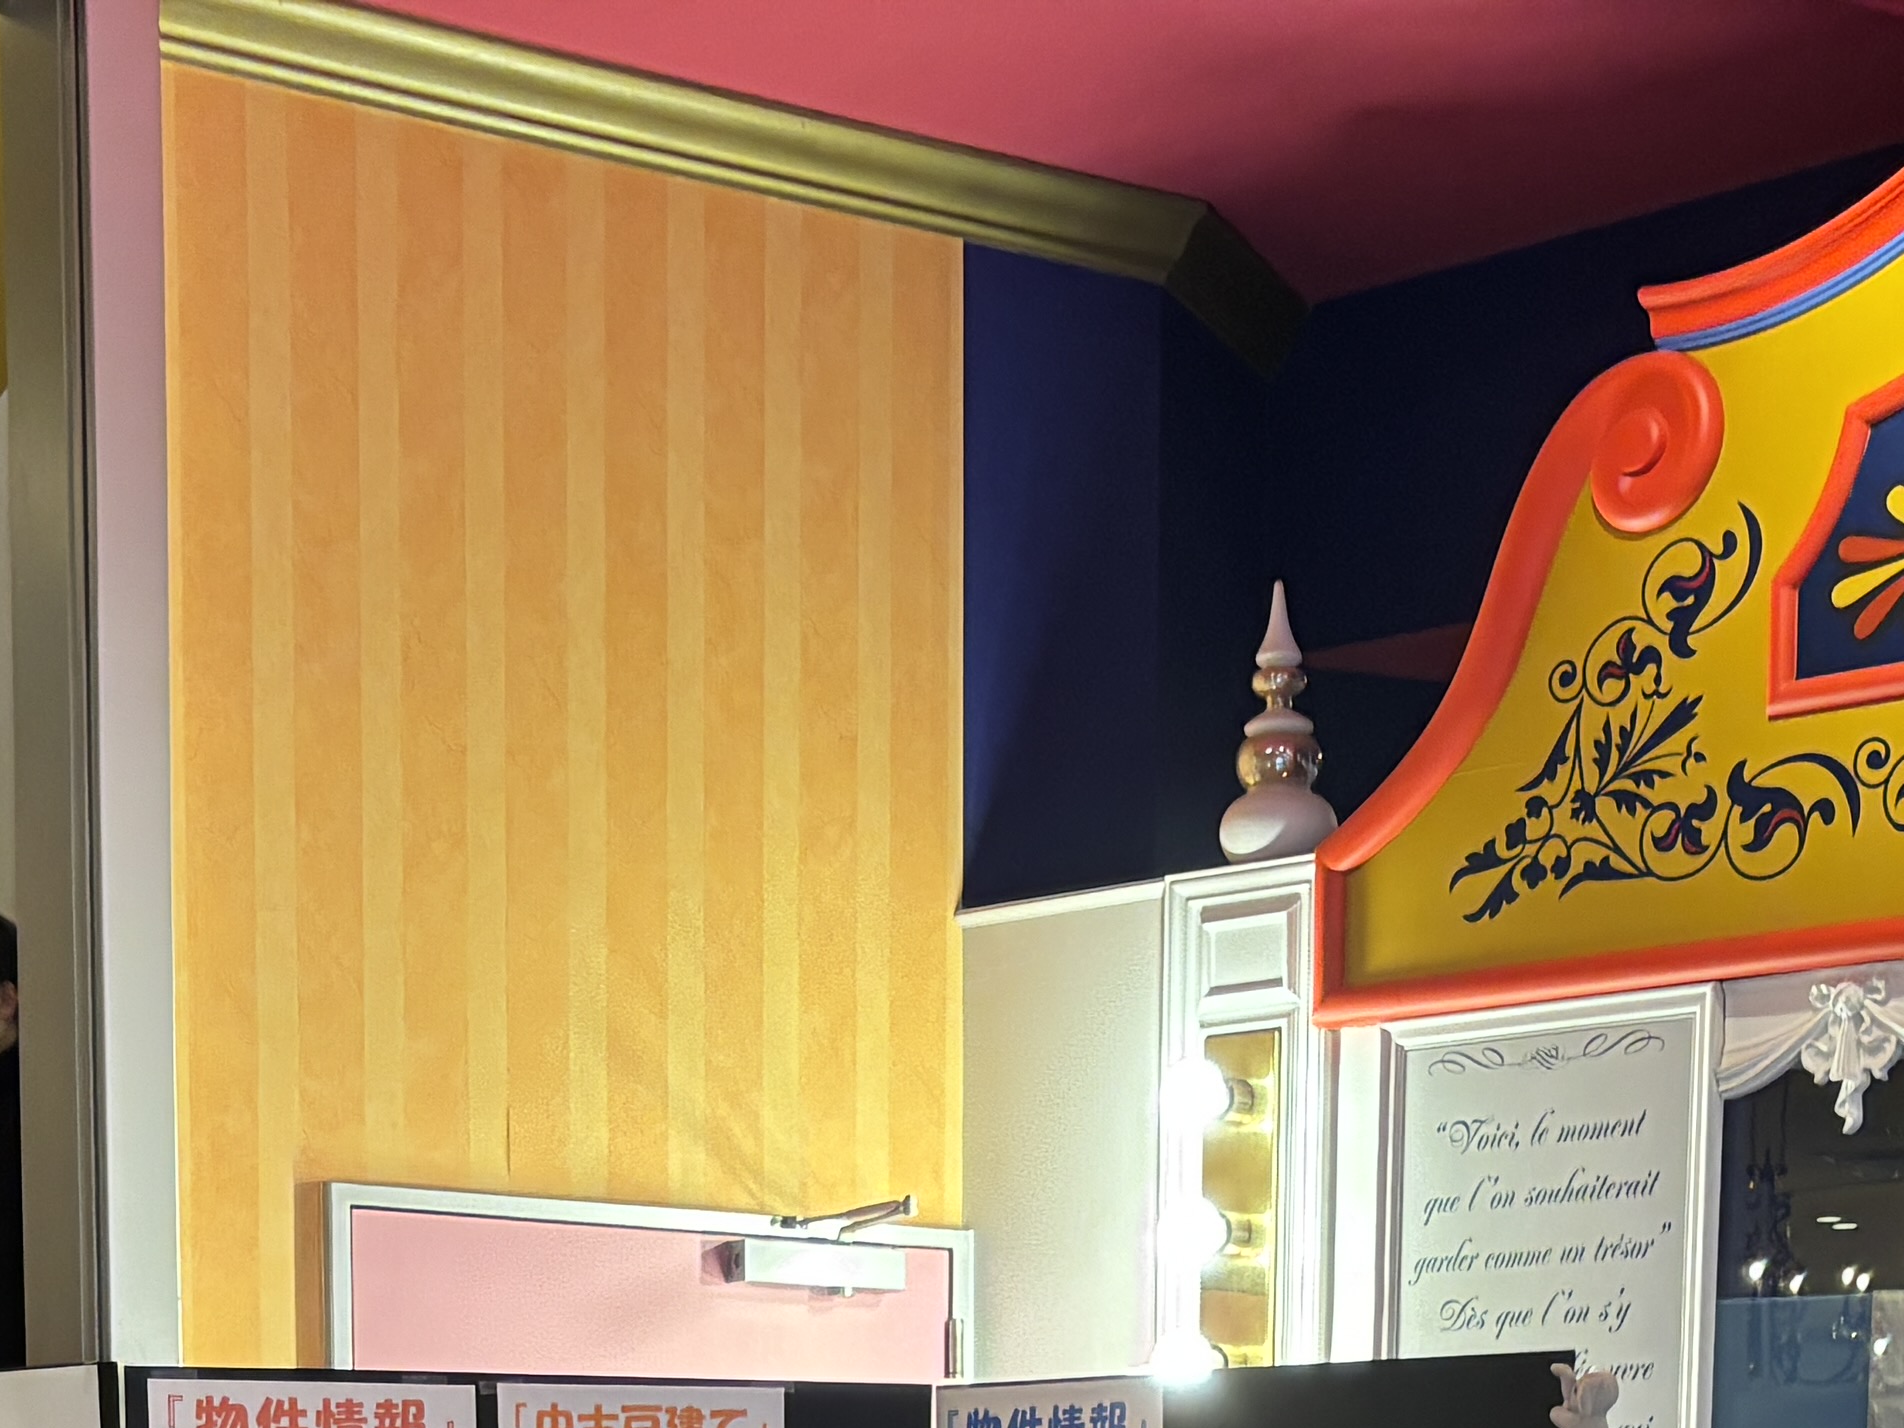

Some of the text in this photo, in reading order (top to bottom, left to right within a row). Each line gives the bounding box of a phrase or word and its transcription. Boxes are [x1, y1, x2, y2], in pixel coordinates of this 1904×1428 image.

[1531, 1107, 1556, 1147] le
[1557, 1109, 1648, 1144] moment
[1424, 1193, 1460, 1226] que
[1524, 1165, 1661, 1206] souhaiterait
[1408, 1236, 1480, 1287] garder
[1484, 1246, 1553, 1270] comme
[1560, 1242, 1586, 1264] un
[1495, 1308, 1534, 1340] que
